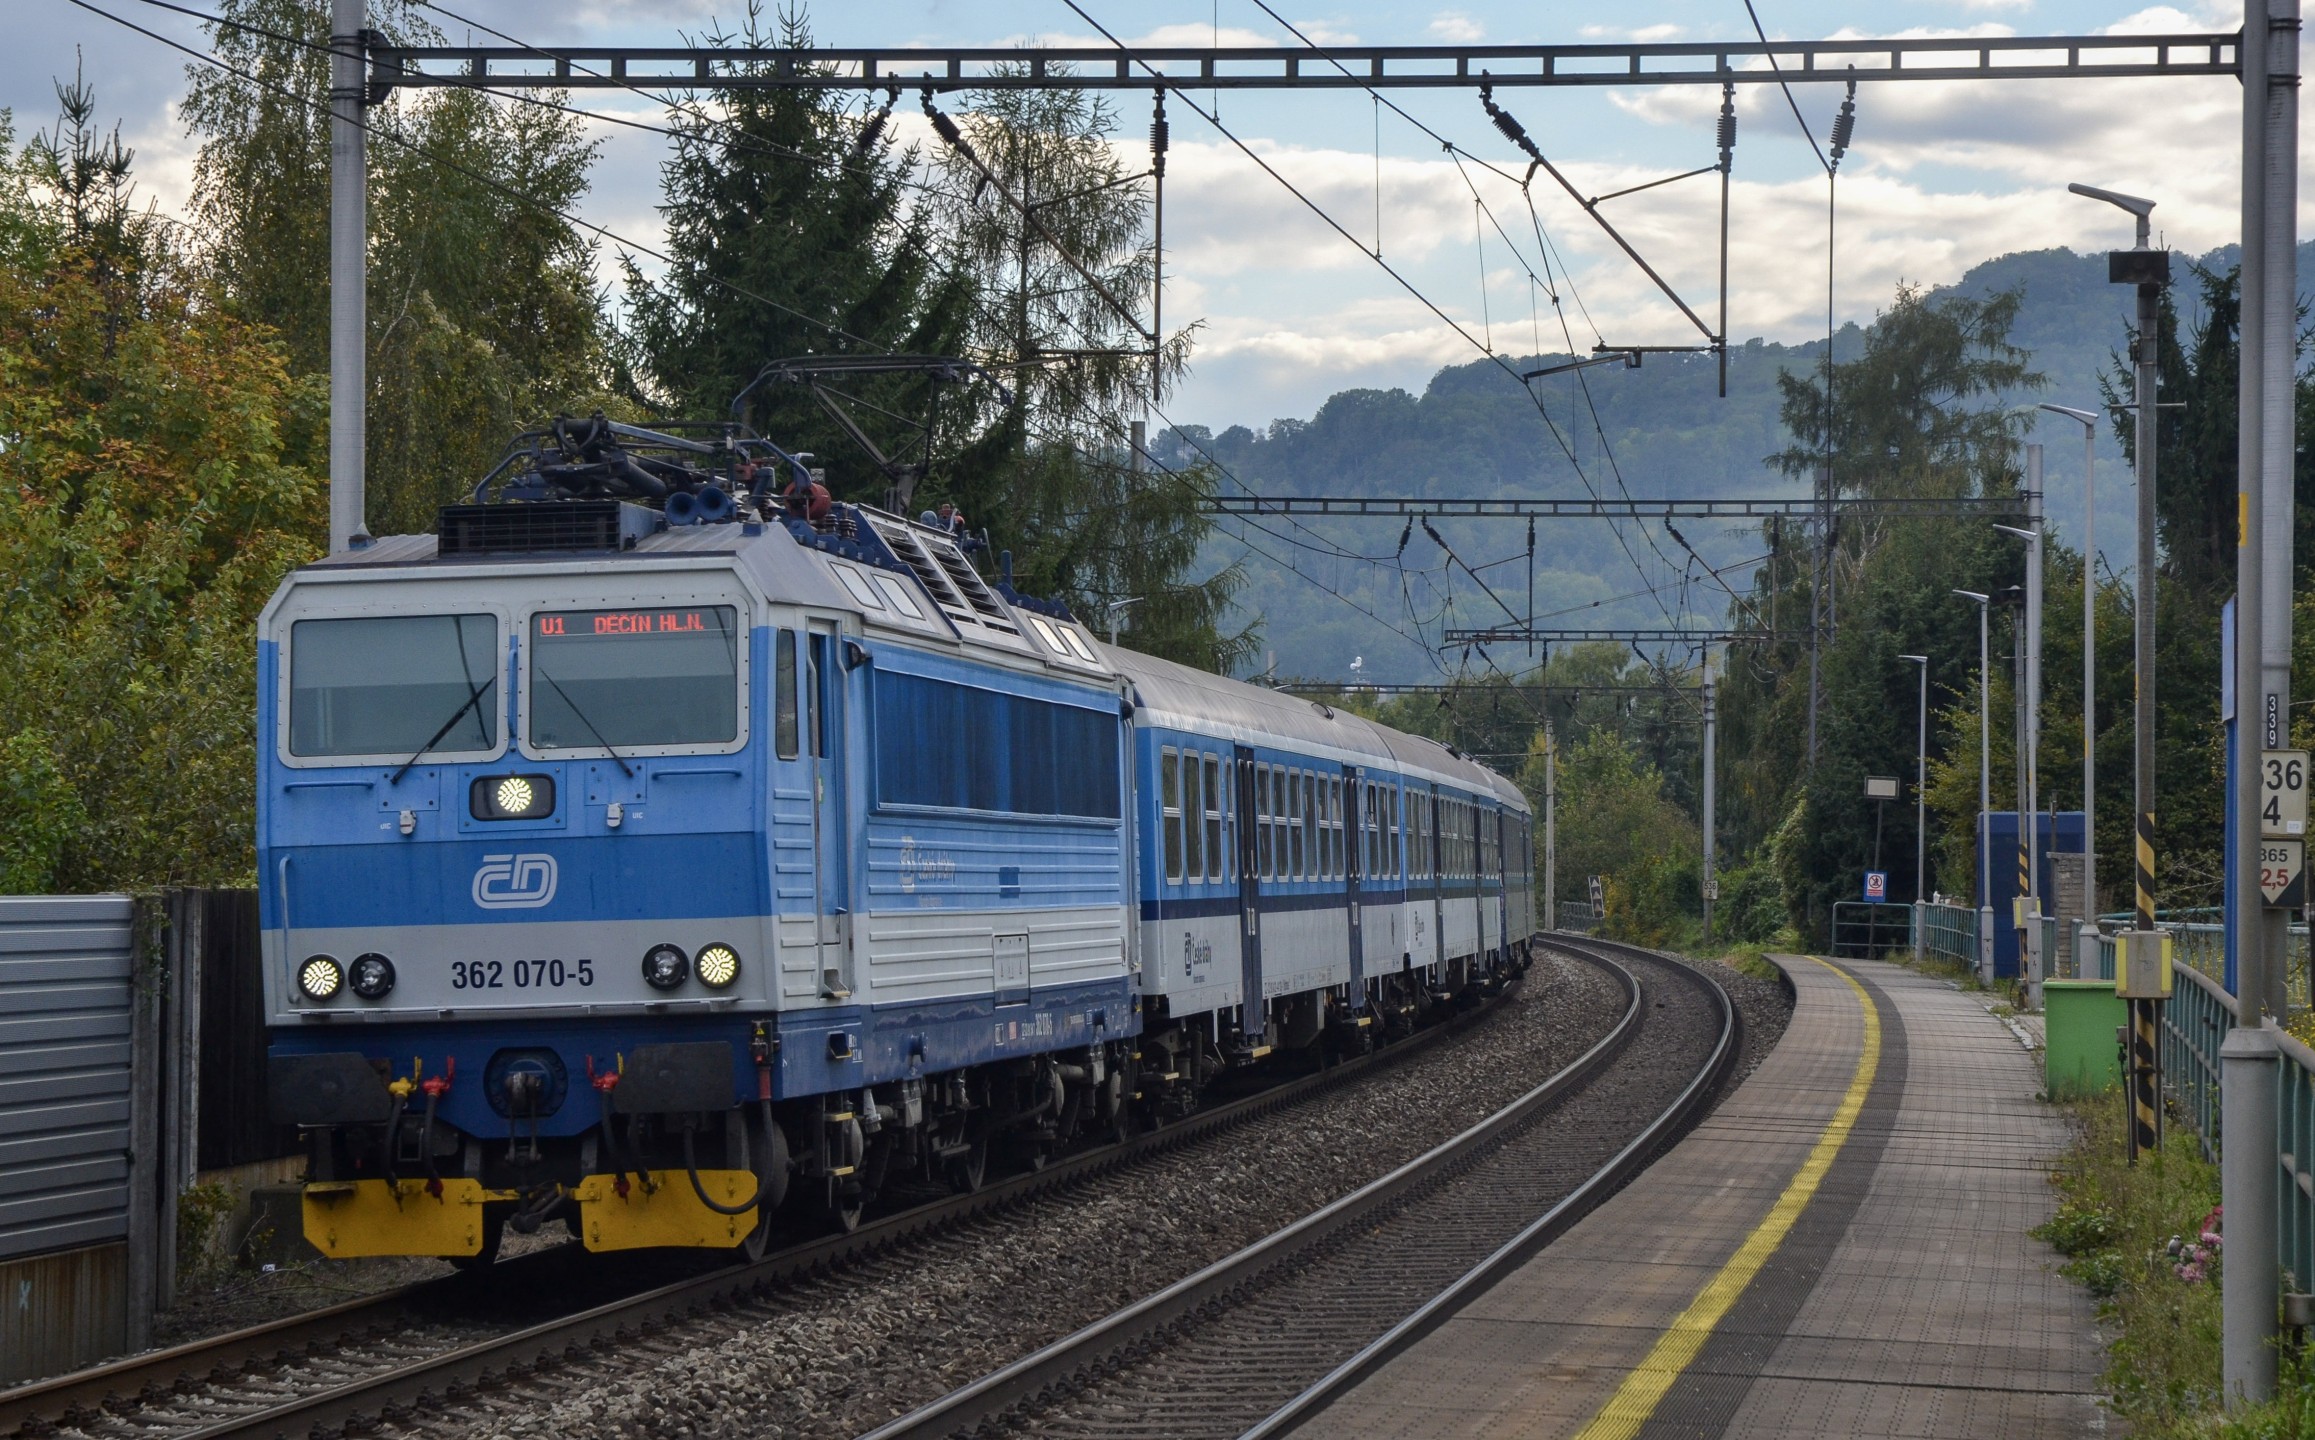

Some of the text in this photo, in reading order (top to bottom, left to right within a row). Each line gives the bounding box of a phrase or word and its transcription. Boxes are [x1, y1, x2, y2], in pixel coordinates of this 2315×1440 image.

[541, 613, 704, 635] U1 DĚČÍN HL.N.
[2261, 759, 2303, 791] 36
[1704, 882, 1717, 890] 536
[2261, 868, 2289, 890] 2,5
[451, 959, 594, 989] 362 070-5
